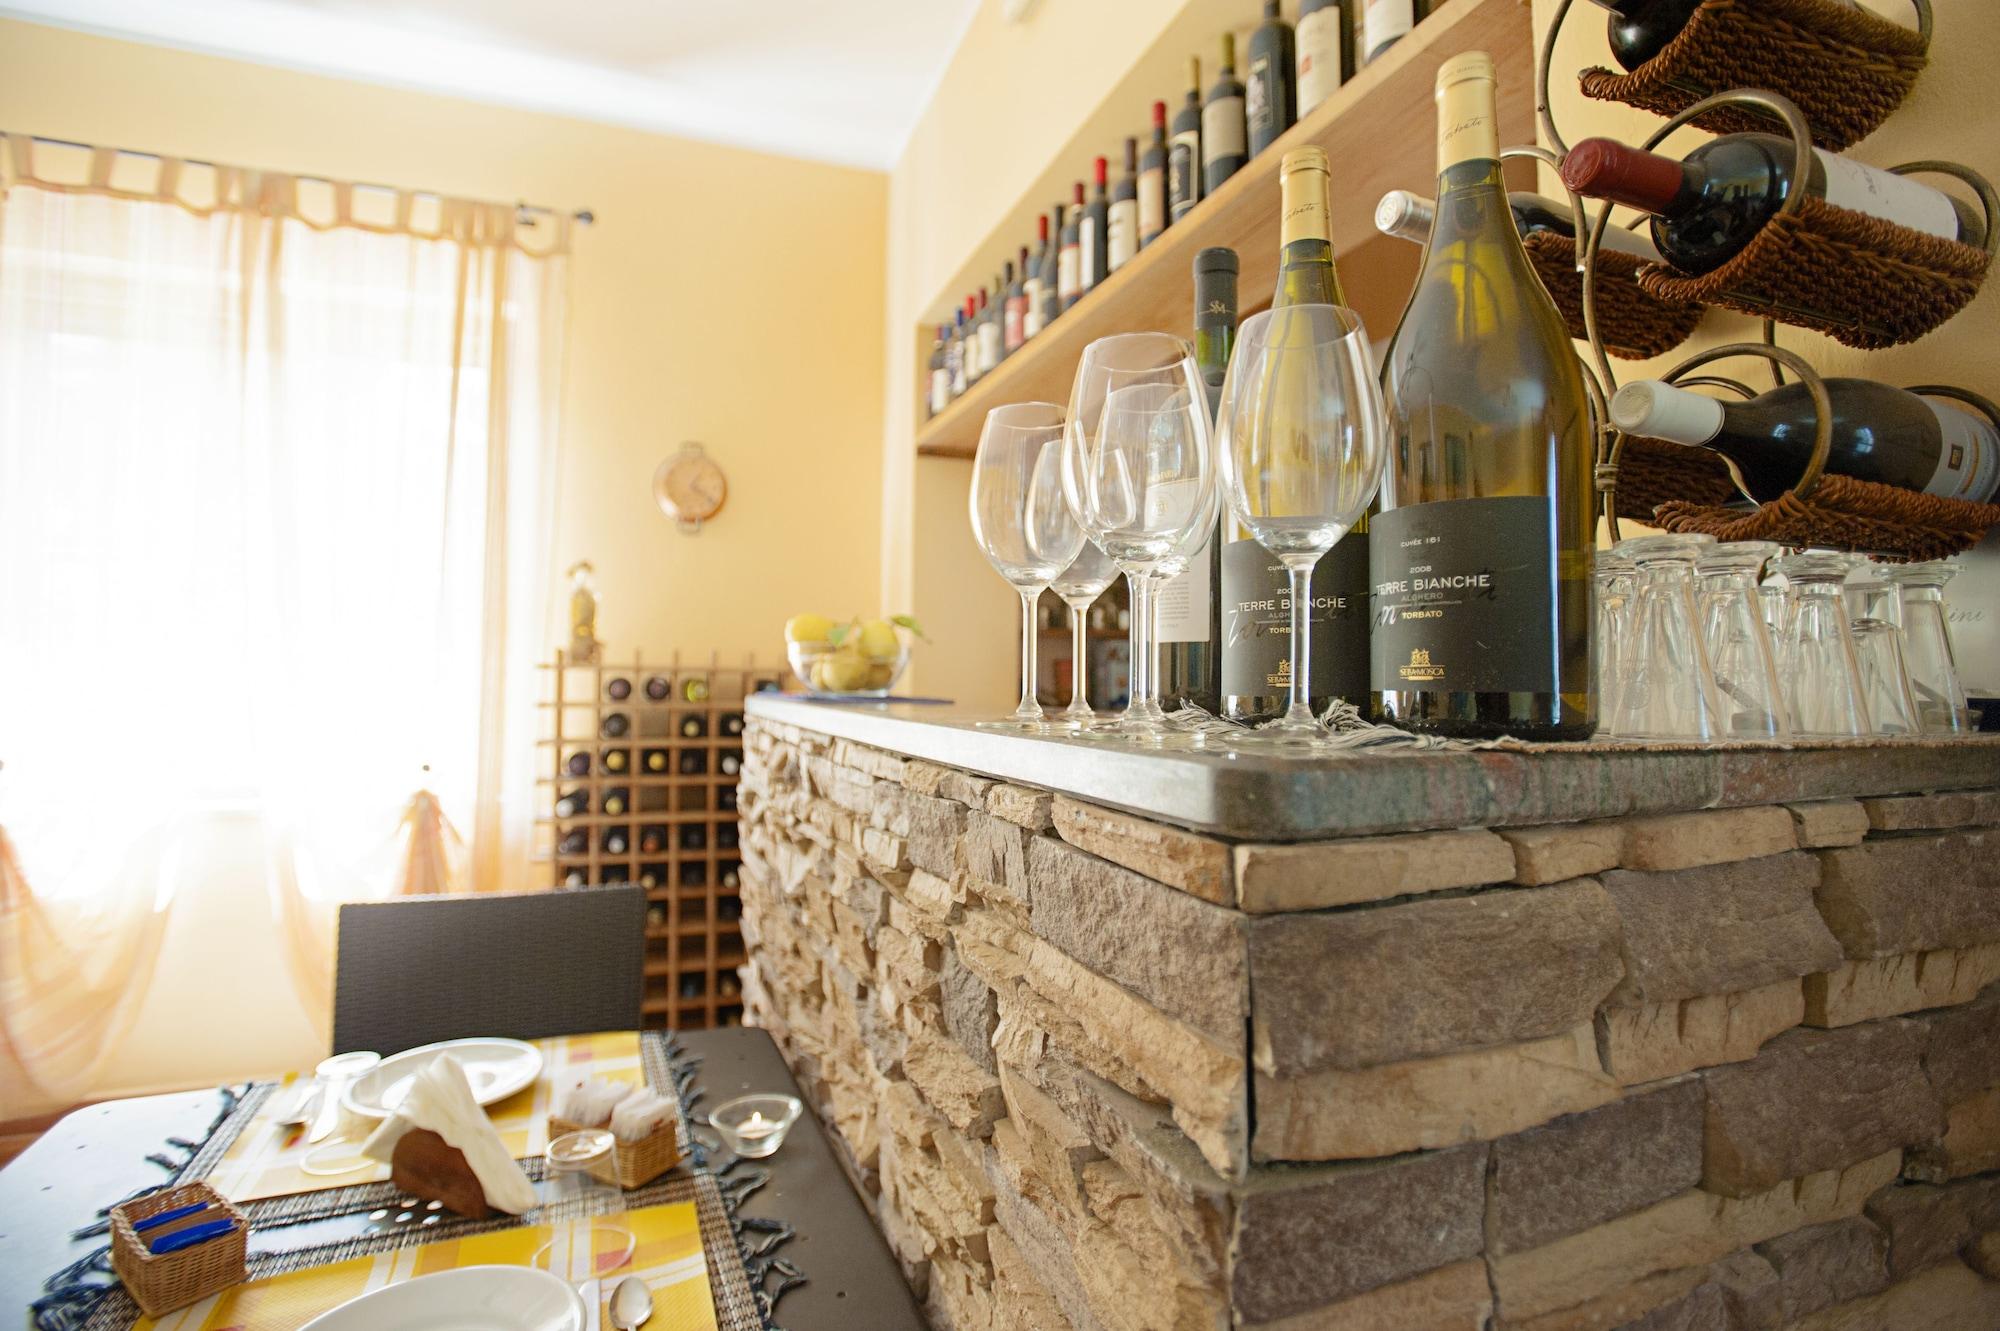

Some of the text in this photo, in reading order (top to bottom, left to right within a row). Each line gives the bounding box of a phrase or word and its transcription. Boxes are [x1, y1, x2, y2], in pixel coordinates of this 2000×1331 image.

[1376, 580, 1408, 596] TERRE
[1414, 574, 1490, 591] BIANCHE
[1276, 587, 1292, 595] 200
[1401, 592, 1444, 602] ALGHERO
[1238, 597, 1346, 612] TERRE BNCHE
[1402, 610, 1442, 620] TORBATO
